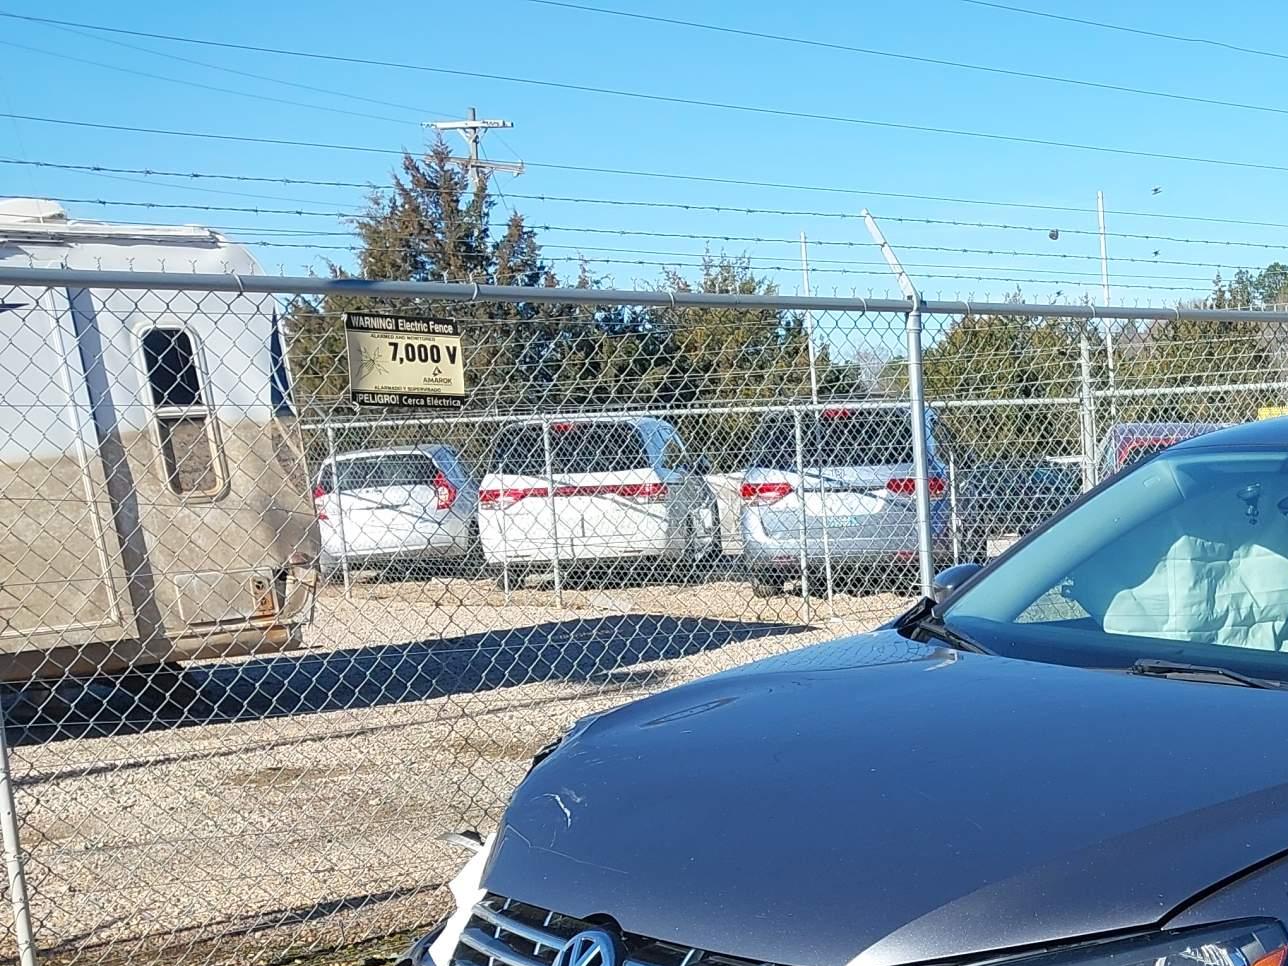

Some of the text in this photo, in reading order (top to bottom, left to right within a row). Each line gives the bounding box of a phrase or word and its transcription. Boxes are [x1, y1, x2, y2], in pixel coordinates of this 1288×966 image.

[350, 315, 453, 334] WARNING! Electric Fence
[388, 342, 457, 365] 7,000 V
[356, 393, 461, 407] ¡PELIGRO! Cerca Eléctrica
